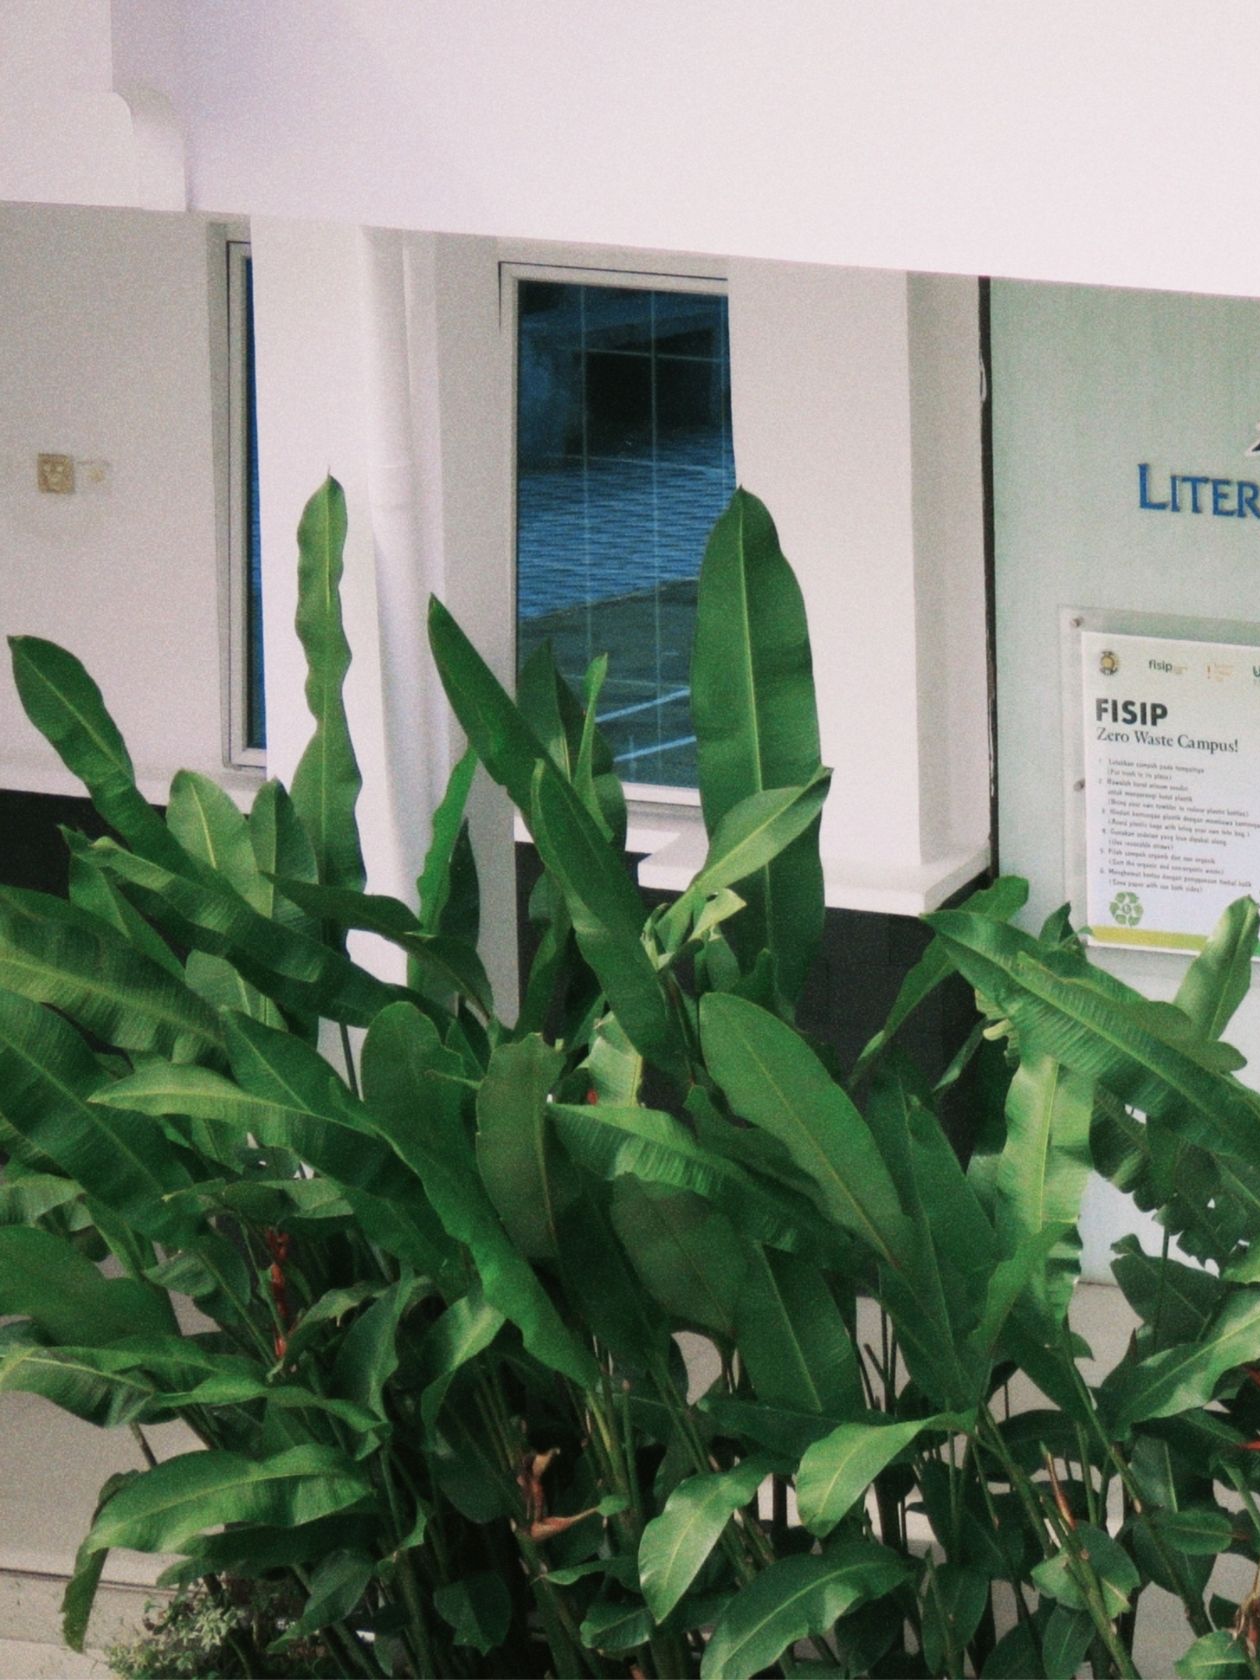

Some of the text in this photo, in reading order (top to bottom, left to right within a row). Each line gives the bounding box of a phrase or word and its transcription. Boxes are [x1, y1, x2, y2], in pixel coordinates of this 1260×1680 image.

[1149, 659, 1173, 672] fisip
[1095, 698, 1168, 726] FISIP
[1097, 728, 1238, 754] Zero Waste Campus!
